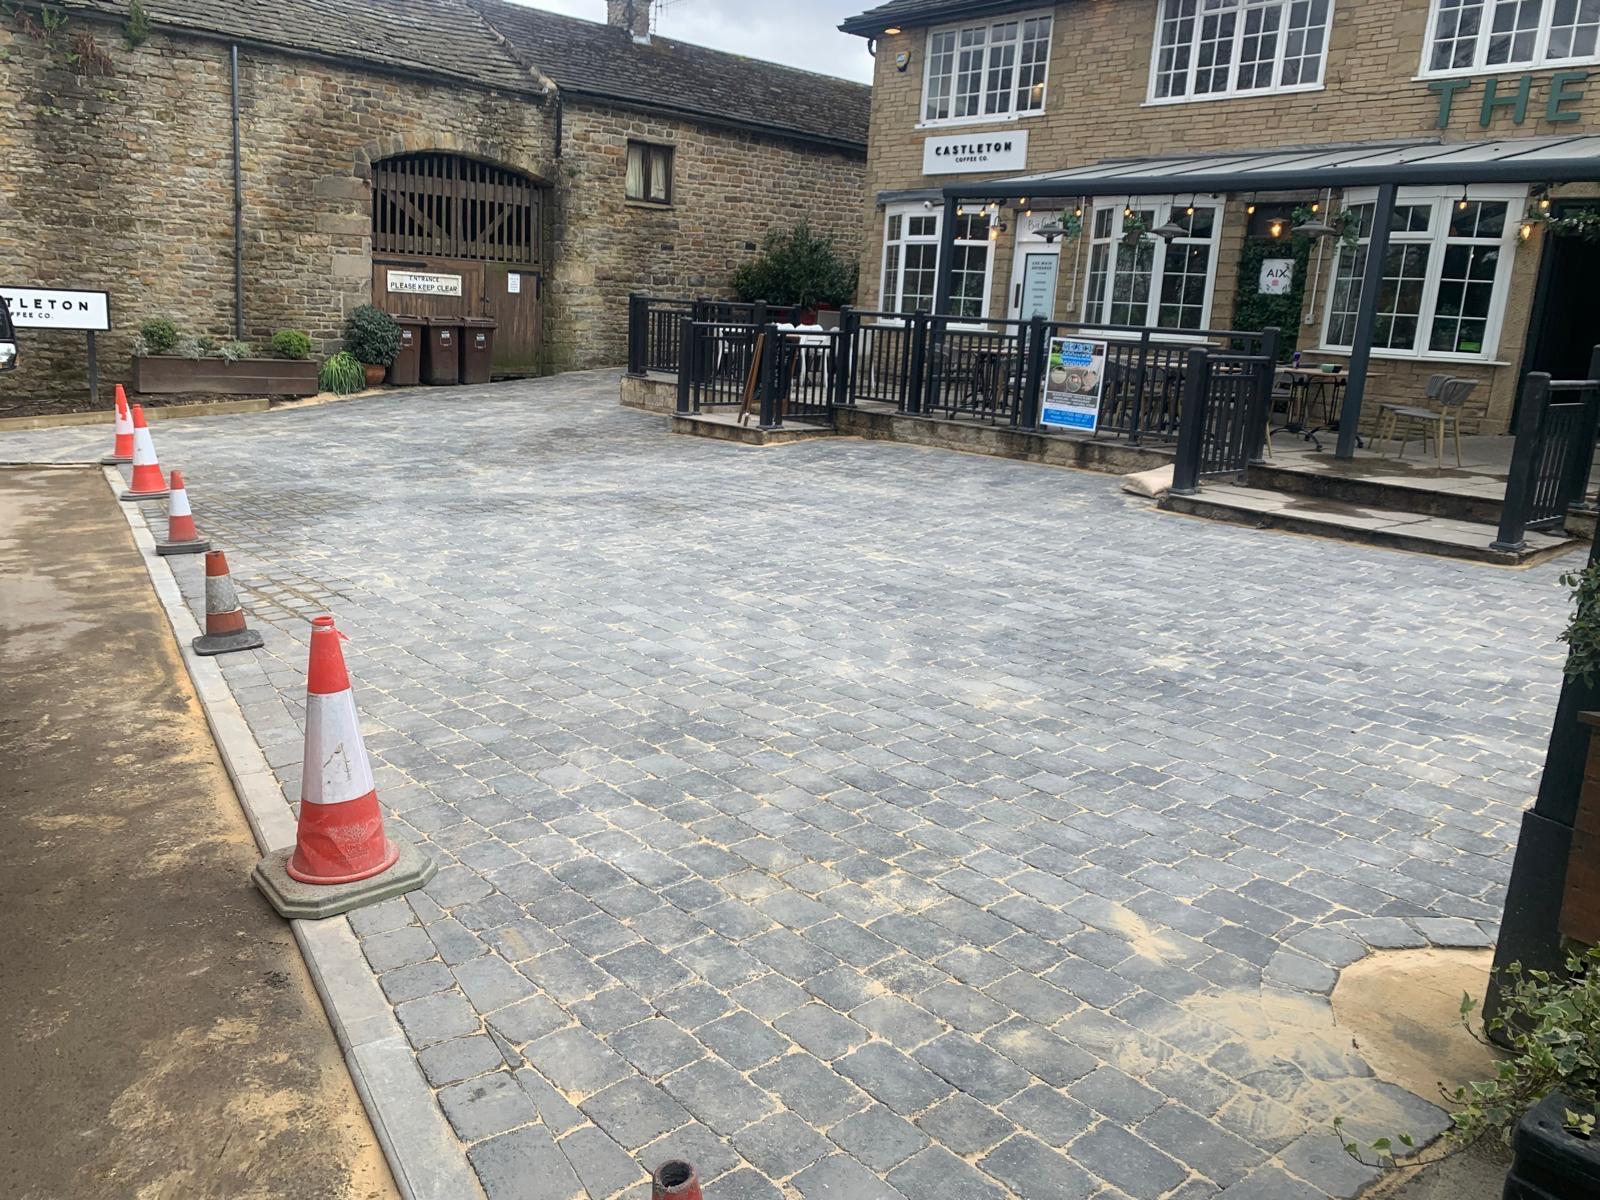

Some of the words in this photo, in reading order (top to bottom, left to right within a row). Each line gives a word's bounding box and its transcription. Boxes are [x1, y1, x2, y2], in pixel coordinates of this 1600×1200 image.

[1428, 72, 1589, 129] THE
[935, 142, 1012, 156] CASTLETON
[409, 275, 440, 283] ENTRANCE
[1266, 269, 1287, 278] AIX
[390, 282, 417, 290] PLEASE
[436, 285, 458, 293] CLEAR
